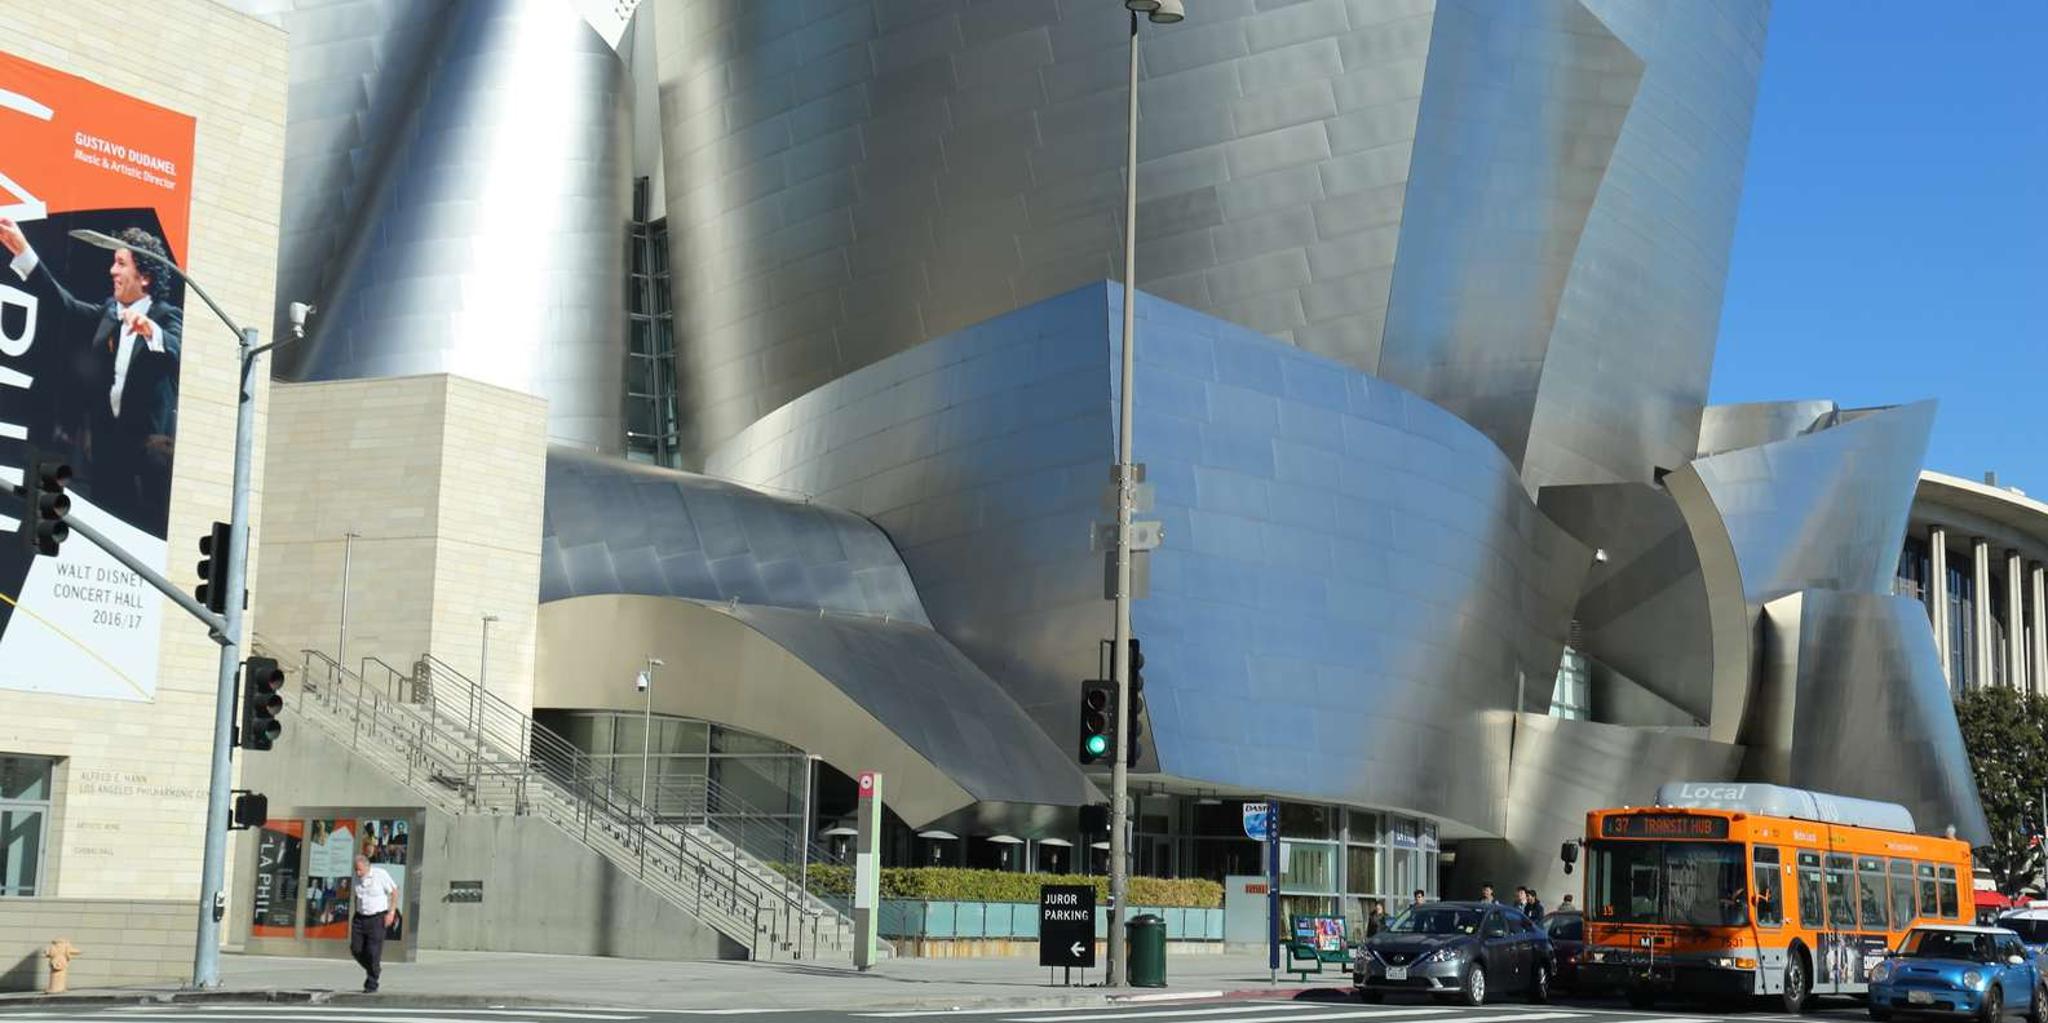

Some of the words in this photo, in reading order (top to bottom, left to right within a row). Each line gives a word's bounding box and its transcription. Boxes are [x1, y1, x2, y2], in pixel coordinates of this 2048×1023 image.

[74, 131, 126, 159] GUSTAVO
[127, 148, 177, 177] DUDAMEL
[74, 148, 101, 167] Music
[102, 157, 111, 170] &
[110, 161, 143, 181] Artistic
[142, 170, 177, 191] Director
[56, 563, 92, 580] WALT
[53, 583, 112, 604] CONCERT
[114, 591, 143, 609] HALL
[123, 774, 148, 784] MANN
[79, 783, 94, 795] LOS
[97, 784, 134, 796] ANGELES
[136, 786, 194, 800] PHILHARMONIC
[1681, 783, 1746, 800] Local
[1615, 817, 1629, 834] 37
[1644, 817, 1688, 834] TRANSIT
[1690, 818, 1713, 834] HUB
[260, 843, 275, 868] LA
[255, 873, 272, 920] PHIL
[1044, 893, 1078, 905] JUROR
[1044, 909, 1089, 921] PARKING
